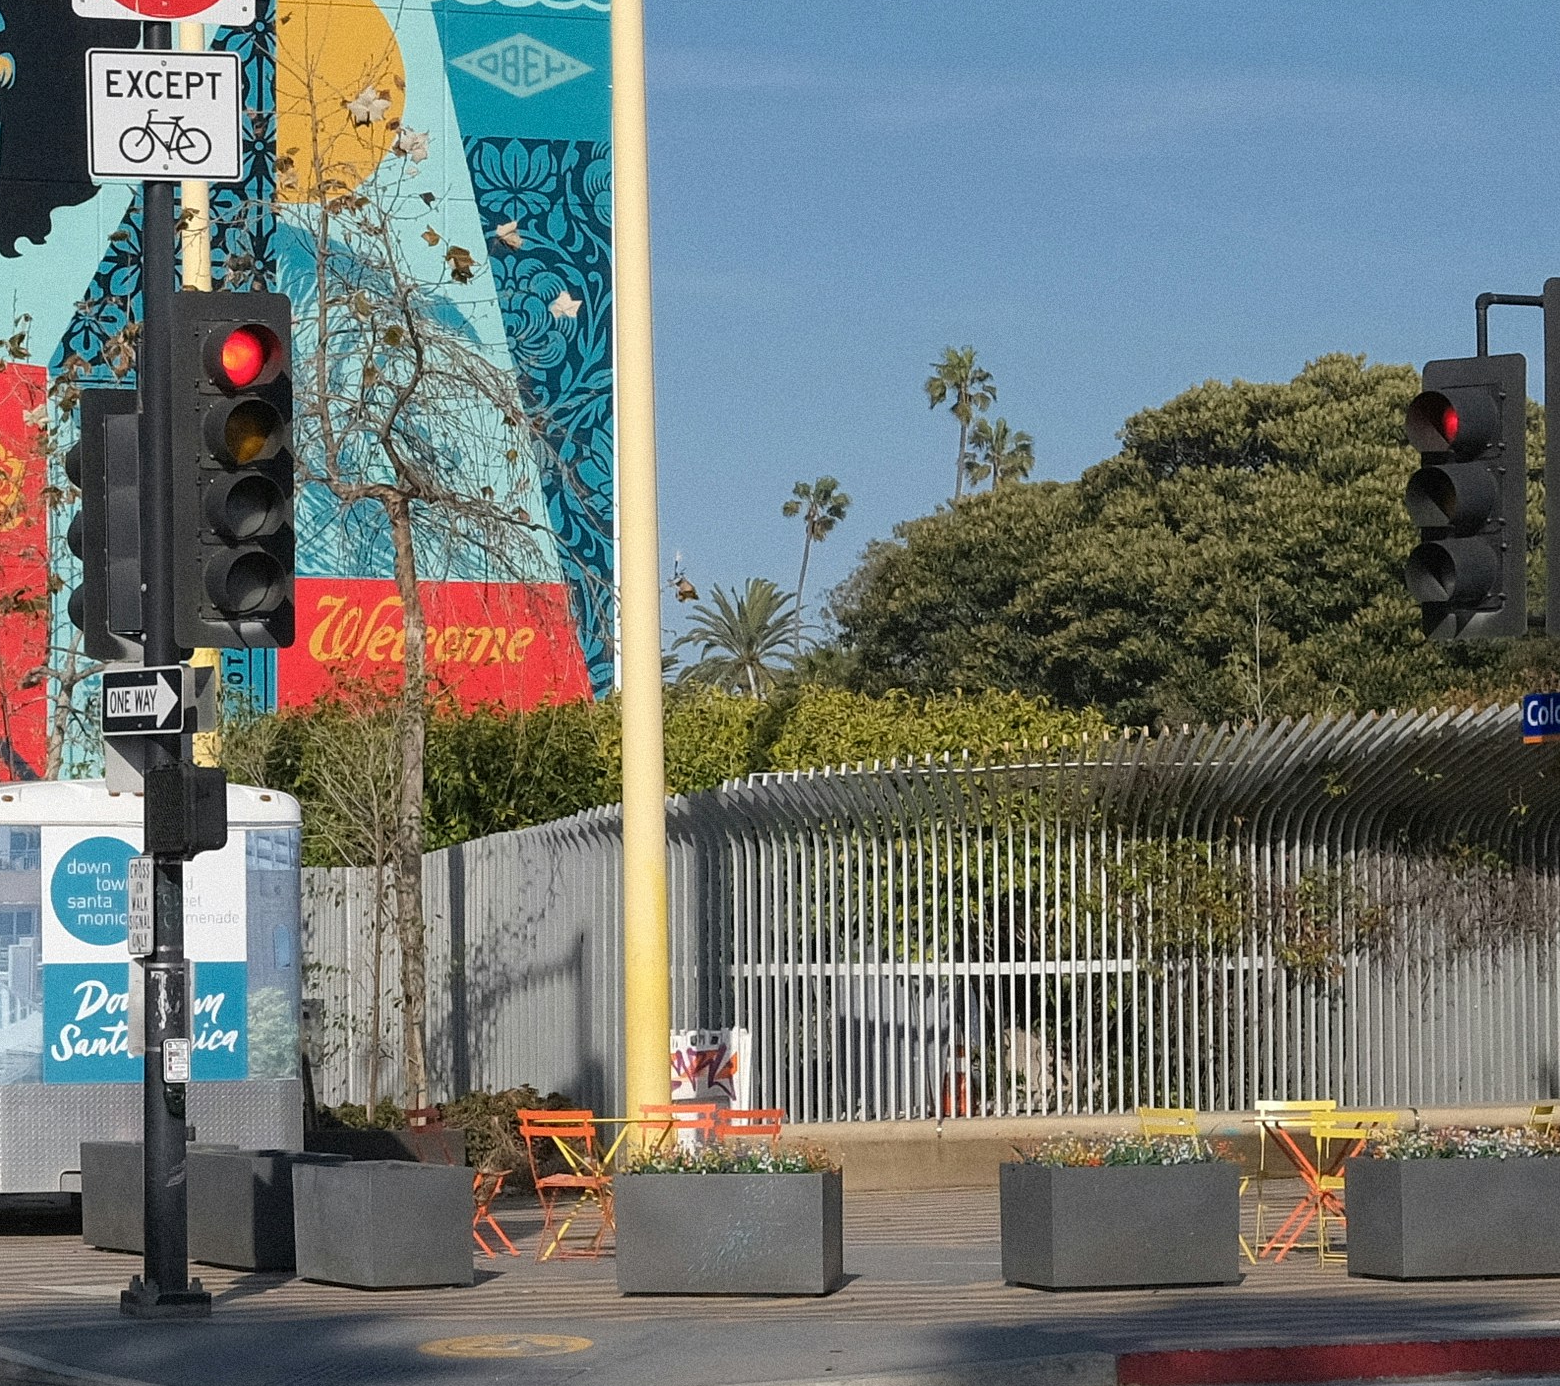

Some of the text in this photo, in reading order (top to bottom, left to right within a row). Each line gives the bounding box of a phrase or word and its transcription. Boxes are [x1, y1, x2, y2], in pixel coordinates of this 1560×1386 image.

[477, 44, 566, 88] OBEY
[106, 69, 222, 100] EXCEPT
[309, 595, 536, 662] Weome
[109, 688, 158, 714] ONE WAY
[67, 858, 111, 874] down
[96, 876, 128, 892] tow
[67, 895, 112, 909] santa
[79, 909, 128, 926] monic
[185, 912, 240, 925] menade
